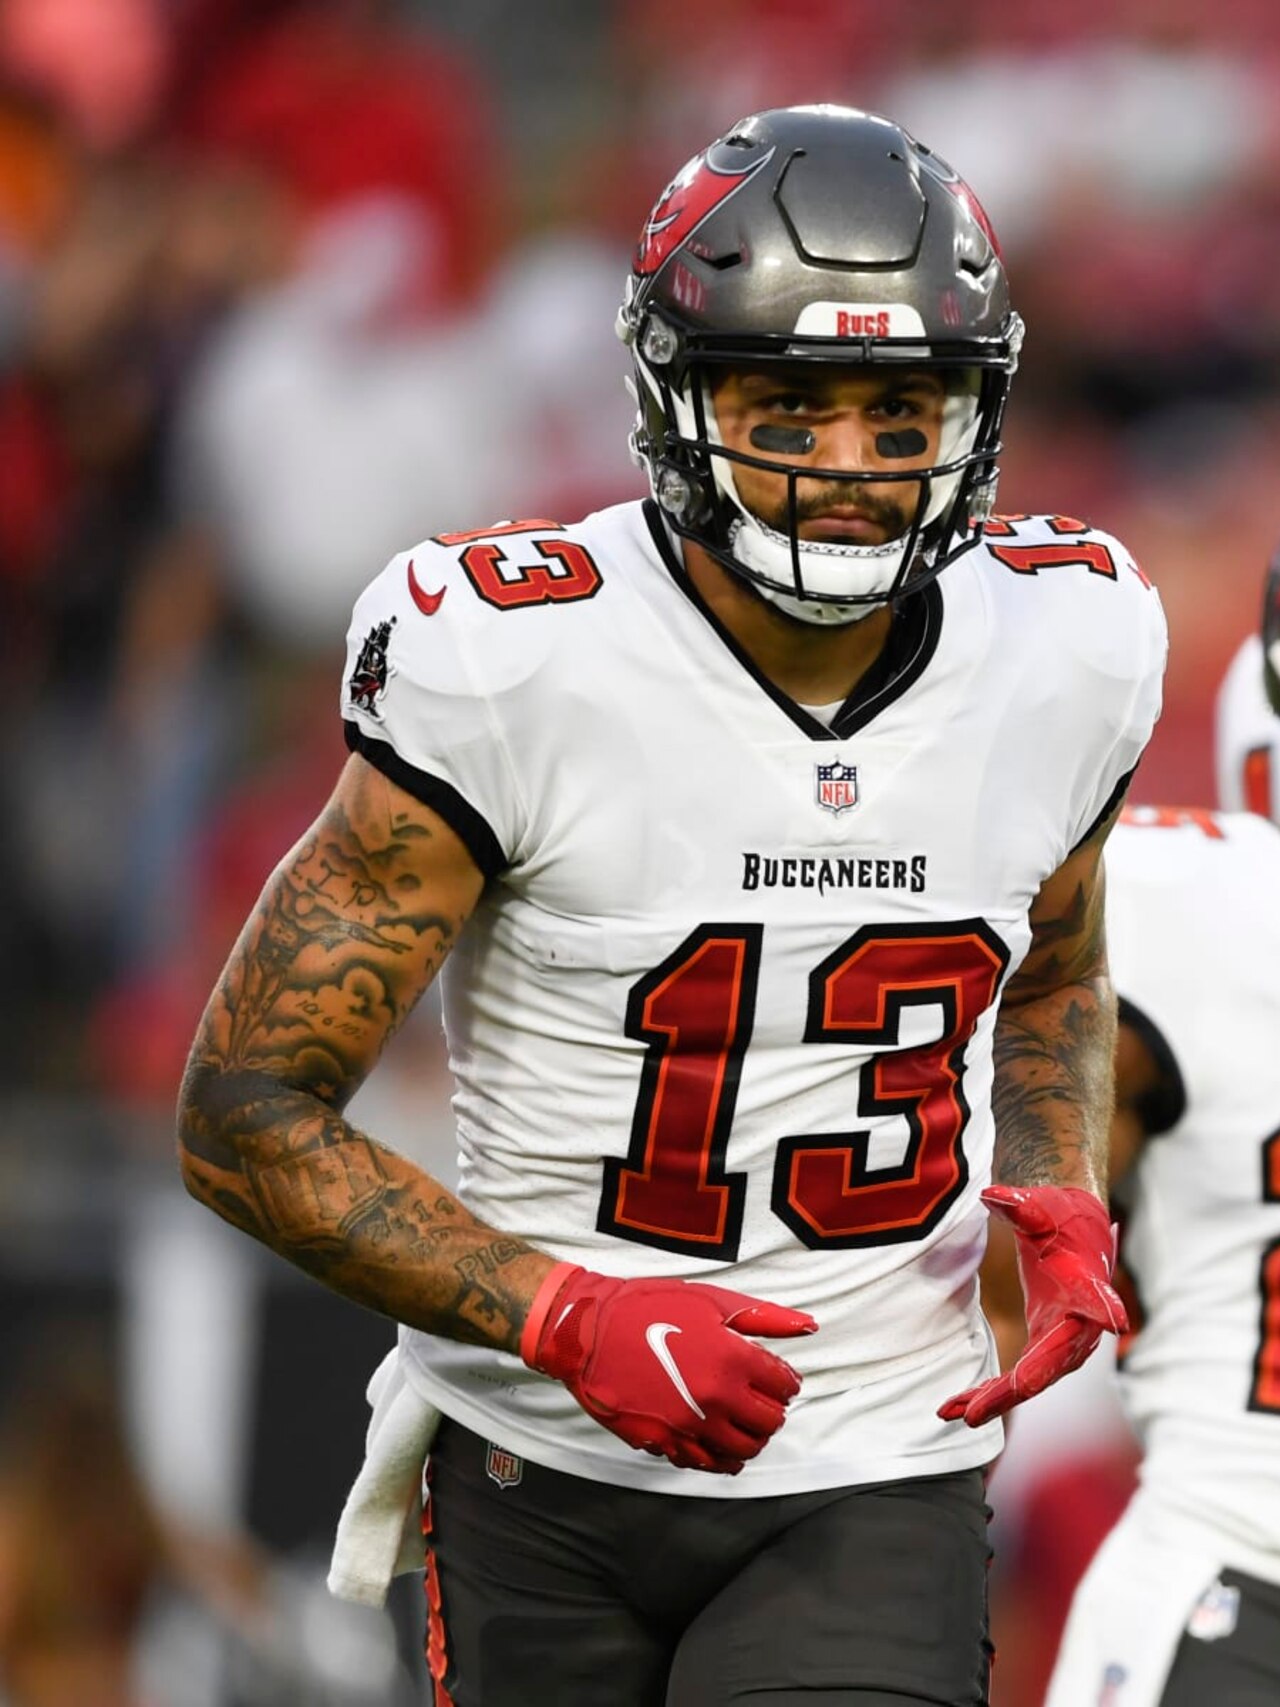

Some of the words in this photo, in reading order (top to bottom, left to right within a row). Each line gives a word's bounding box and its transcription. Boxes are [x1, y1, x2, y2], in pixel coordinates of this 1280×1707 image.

[836, 311, 889, 338] BUCS
[821, 783, 854, 806] NFL
[742, 853, 926, 897] BUCCANEERS
[596, 917, 1011, 1262] 13
[492, 1451, 519, 1480] NFL
